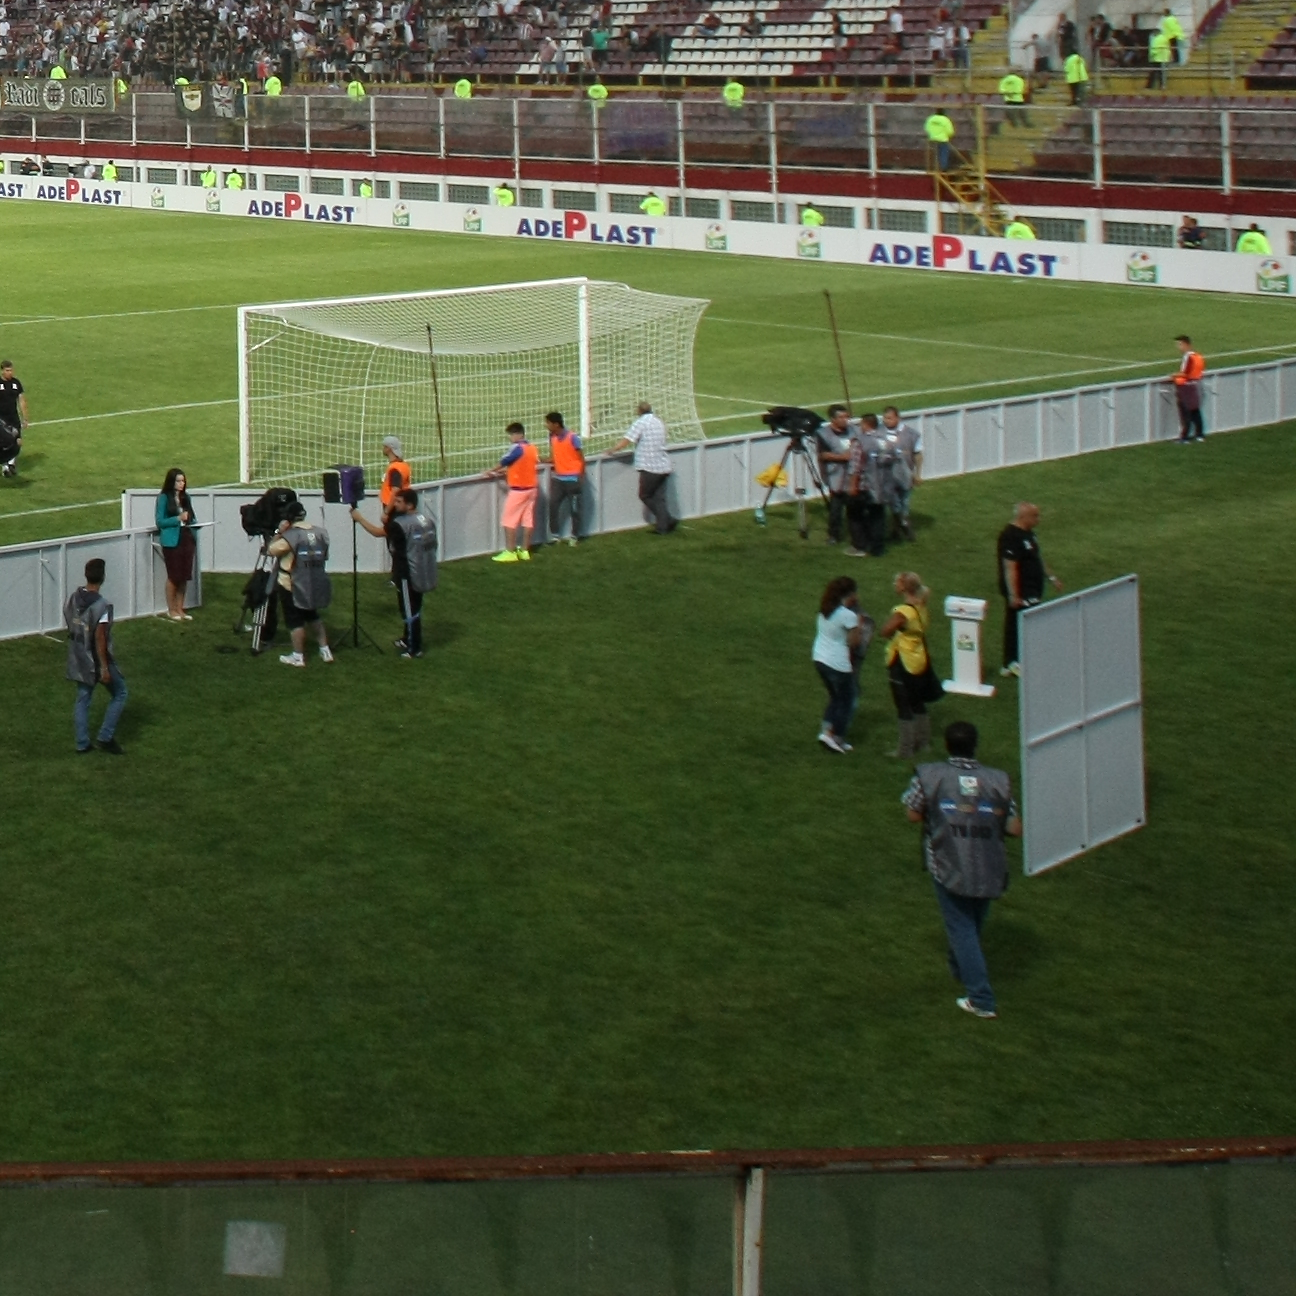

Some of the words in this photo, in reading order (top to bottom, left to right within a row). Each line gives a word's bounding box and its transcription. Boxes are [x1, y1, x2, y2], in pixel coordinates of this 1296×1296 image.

[37, 179, 121, 205] ADEPLAST
[248, 193, 354, 222] ADEPLAST
[393, 216, 409, 226] LPF
[517, 211, 656, 245] ADEPLAST
[869, 235, 1056, 276] ADEPLAST
[1128, 269, 1156, 282] LPF
[1261, 277, 1287, 292] LPF
